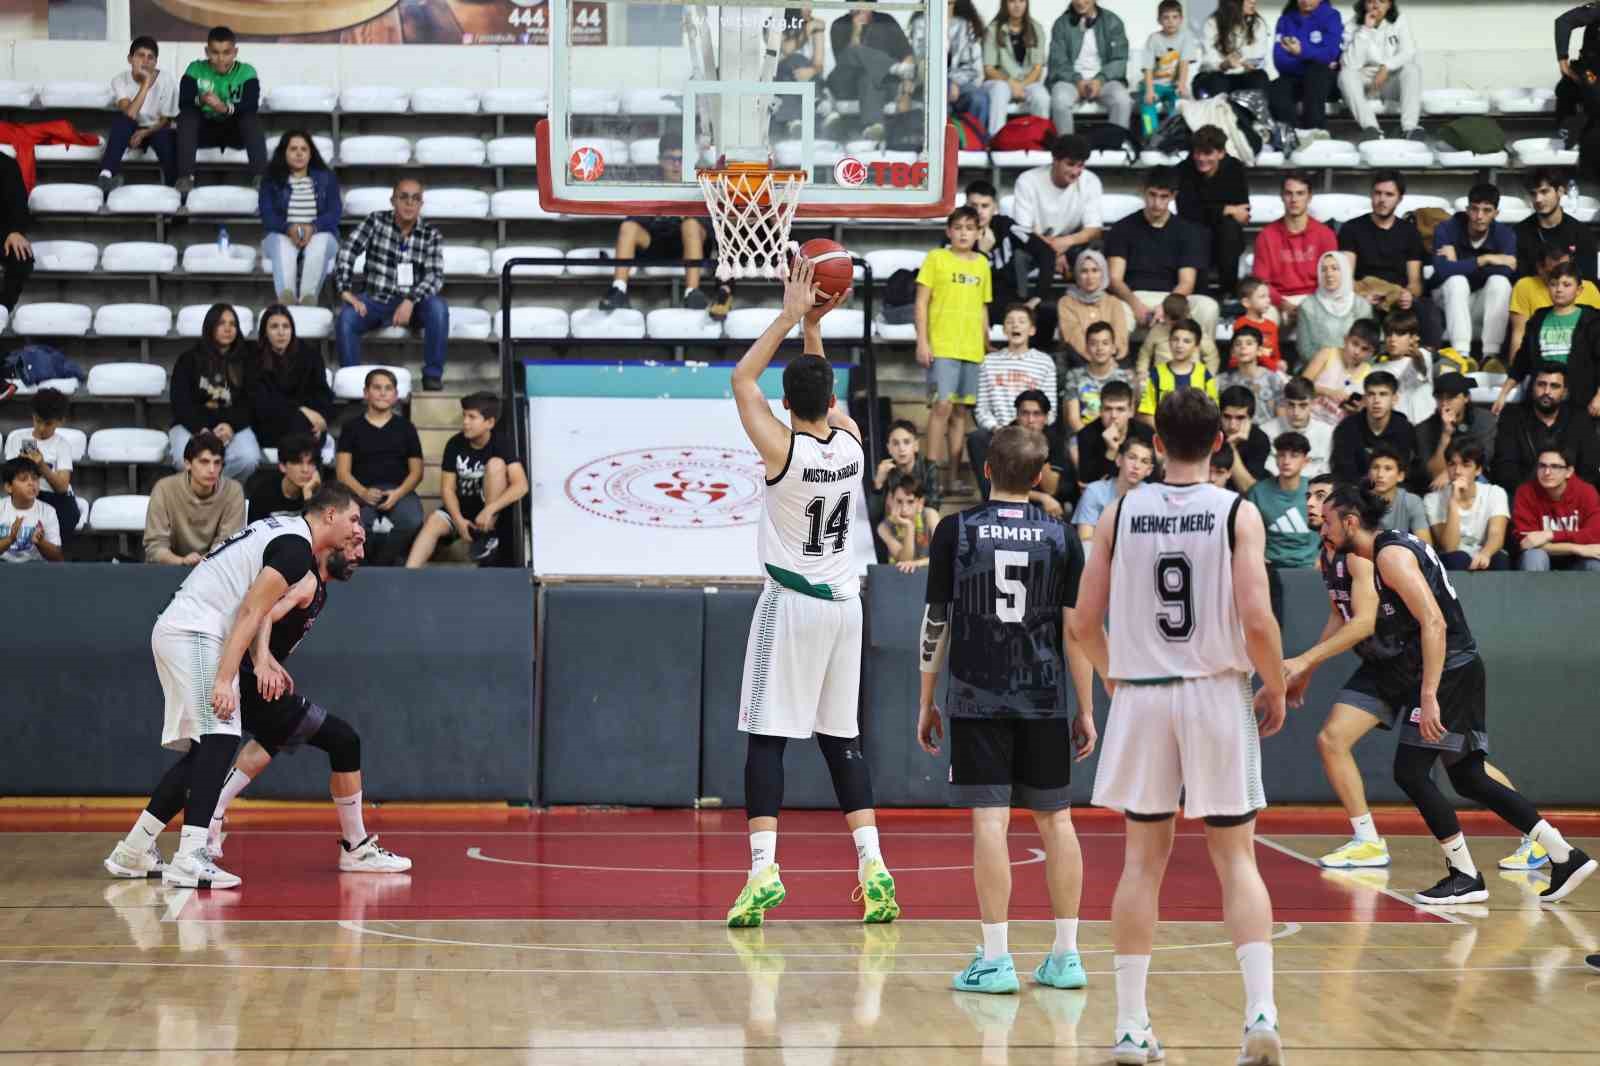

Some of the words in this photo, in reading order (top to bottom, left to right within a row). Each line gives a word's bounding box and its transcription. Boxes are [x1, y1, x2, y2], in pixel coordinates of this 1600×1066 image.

[508, 7, 545, 27] 444
[869, 161, 928, 188] TBF
[802, 467, 836, 483] MUSTAFA
[803, 490, 850, 556] 14
[978, 525, 1043, 541] ERMAT
[1130, 513, 1177, 534] MEHMET
[1179, 509, 1215, 535] MERİÇ
[994, 549, 1029, 623] 5
[1154, 551, 1196, 642] 9
